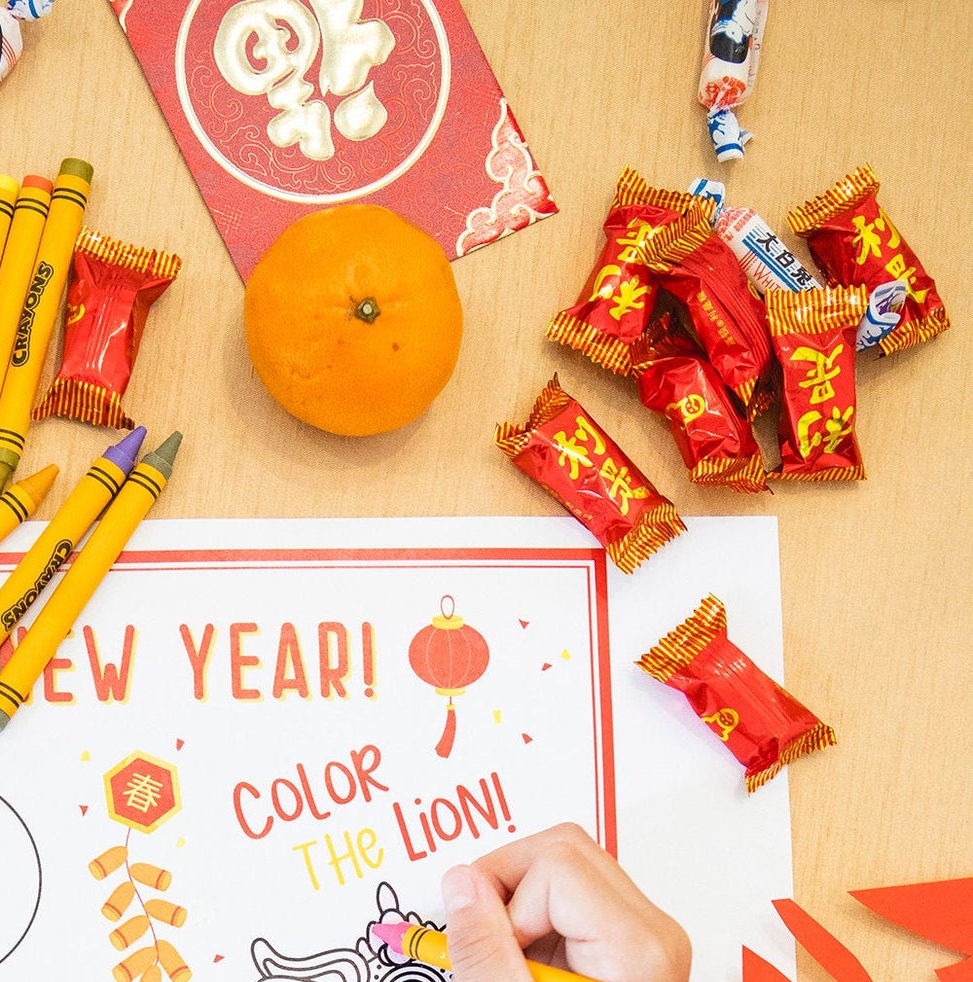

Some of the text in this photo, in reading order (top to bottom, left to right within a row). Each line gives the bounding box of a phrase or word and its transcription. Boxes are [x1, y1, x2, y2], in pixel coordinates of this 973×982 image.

[11, 261, 54, 367] CRAYONS
[1, 539, 72, 632] CRAYONS
[179, 621, 379, 703] YEAR!
[121, 771, 164, 813] 春
[234, 745, 390, 840] COLOR
